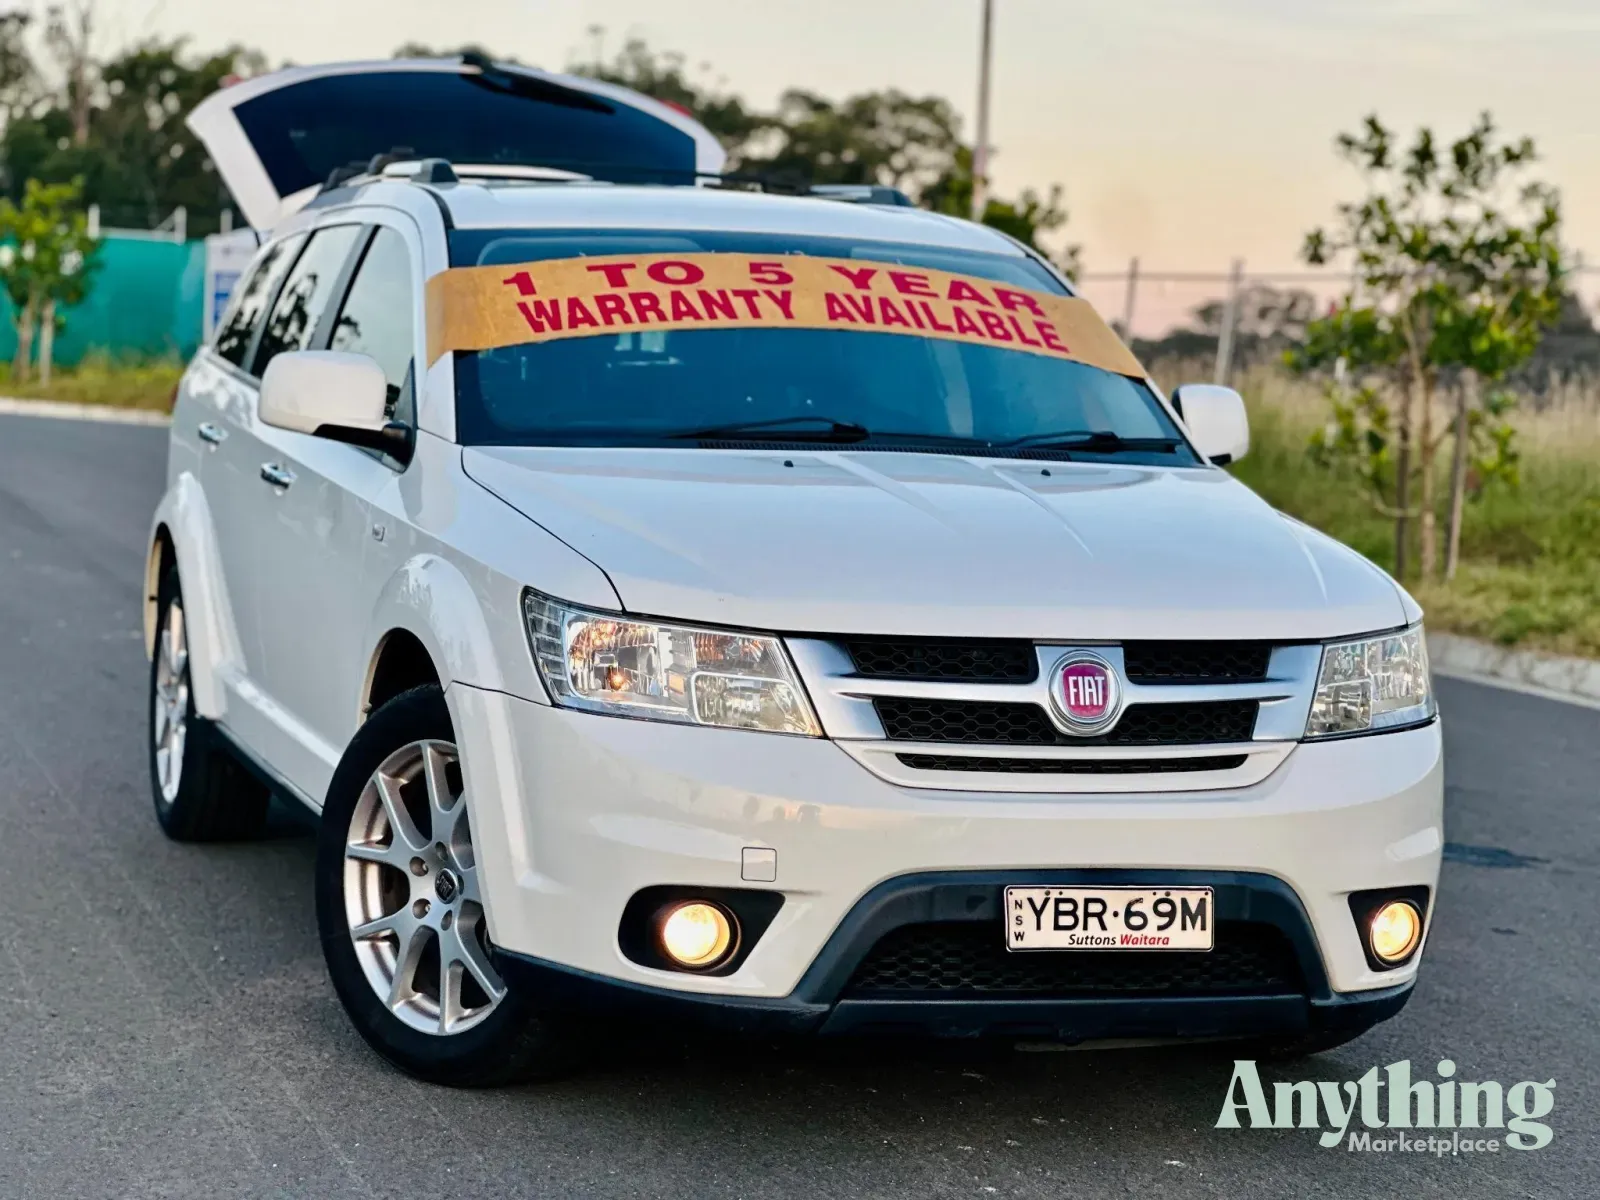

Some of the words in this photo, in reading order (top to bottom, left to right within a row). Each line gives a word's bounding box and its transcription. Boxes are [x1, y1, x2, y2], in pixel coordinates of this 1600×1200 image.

[503, 272, 536, 296] 1
[586, 261, 705, 288] TO
[749, 262, 794, 285] 5
[827, 265, 1046, 317] YEAR
[516, 289, 796, 333] WARRANTY
[824, 292, 1070, 353] AVAILABLE
[1068, 675, 1105, 706] FIAT
[1068, 934, 1117, 946] Suttons
[1120, 934, 1170, 946] Waitara
